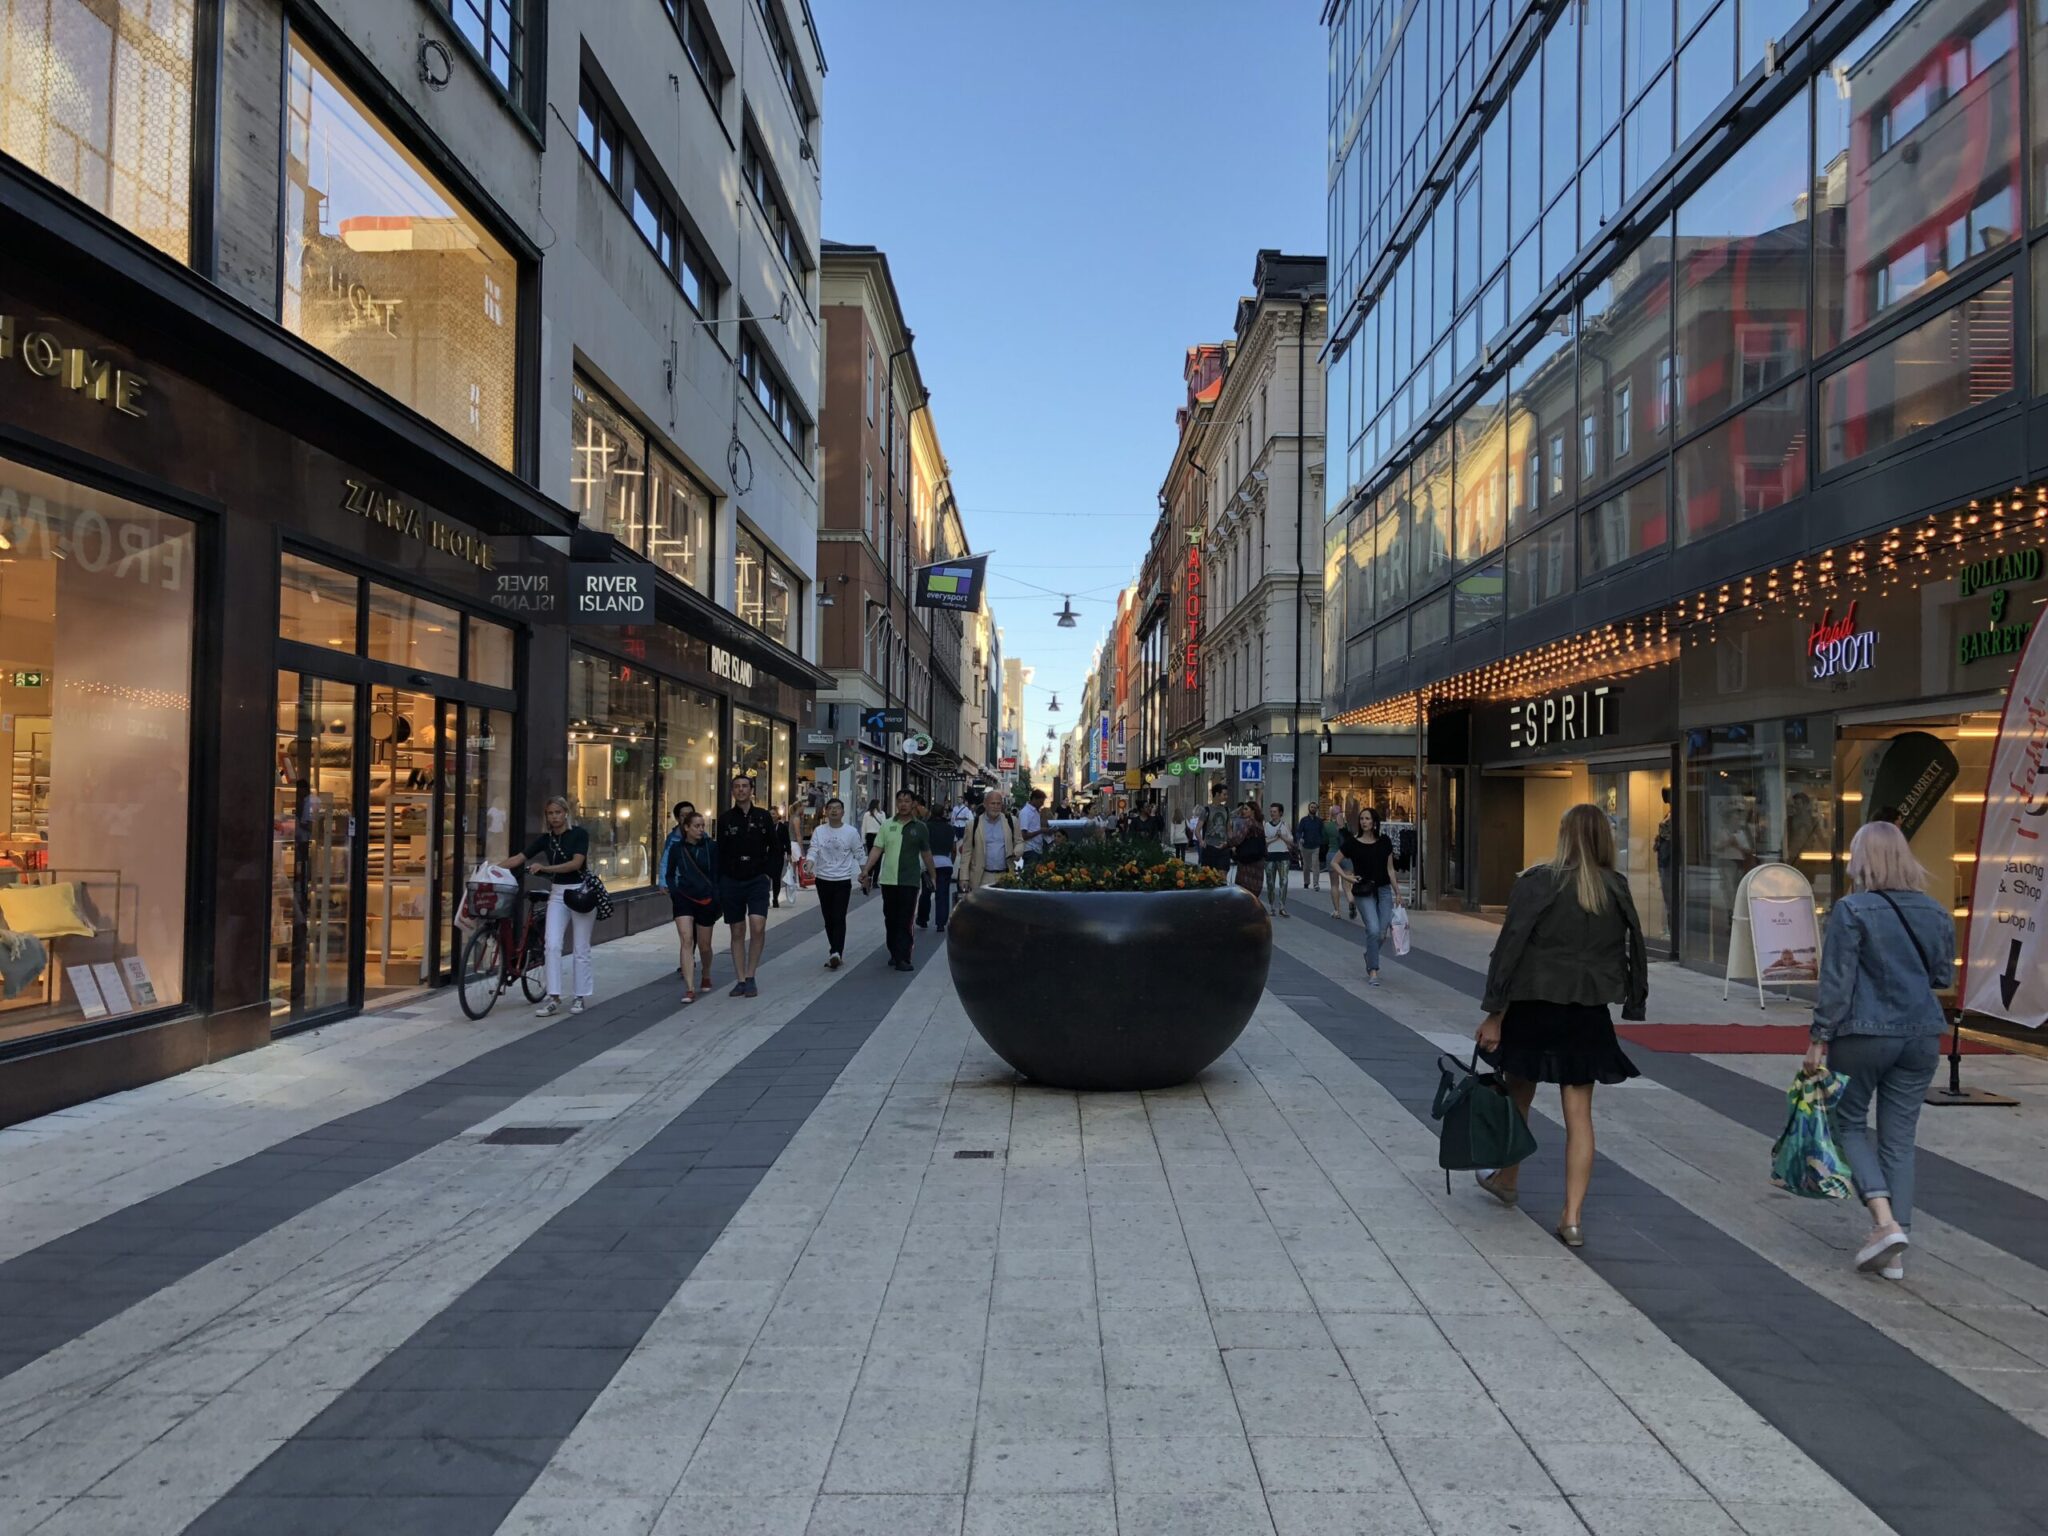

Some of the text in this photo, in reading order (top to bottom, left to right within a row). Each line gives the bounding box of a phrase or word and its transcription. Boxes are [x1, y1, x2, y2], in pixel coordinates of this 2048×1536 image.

[343, 479, 426, 541] ZARA
[586, 576, 637, 593] RIVER
[1958, 548, 2042, 597] HOLLAND
[579, 595, 644, 612] ISLAND
[926, 591, 968, 603] everysport
[1185, 547, 1200, 690] APOTEK
[1808, 600, 1857, 657] Head
[711, 644, 753, 689] RIVER ISLAND
[1813, 630, 1874, 679] SPOT
[1510, 686, 1610, 748] ESPRIT
[1224, 742, 1262, 758] Manhattan
[1905, 759, 1943, 805] BARRETT
[2013, 879, 2042, 901] Shop
[1998, 911, 2026, 932] Drop
